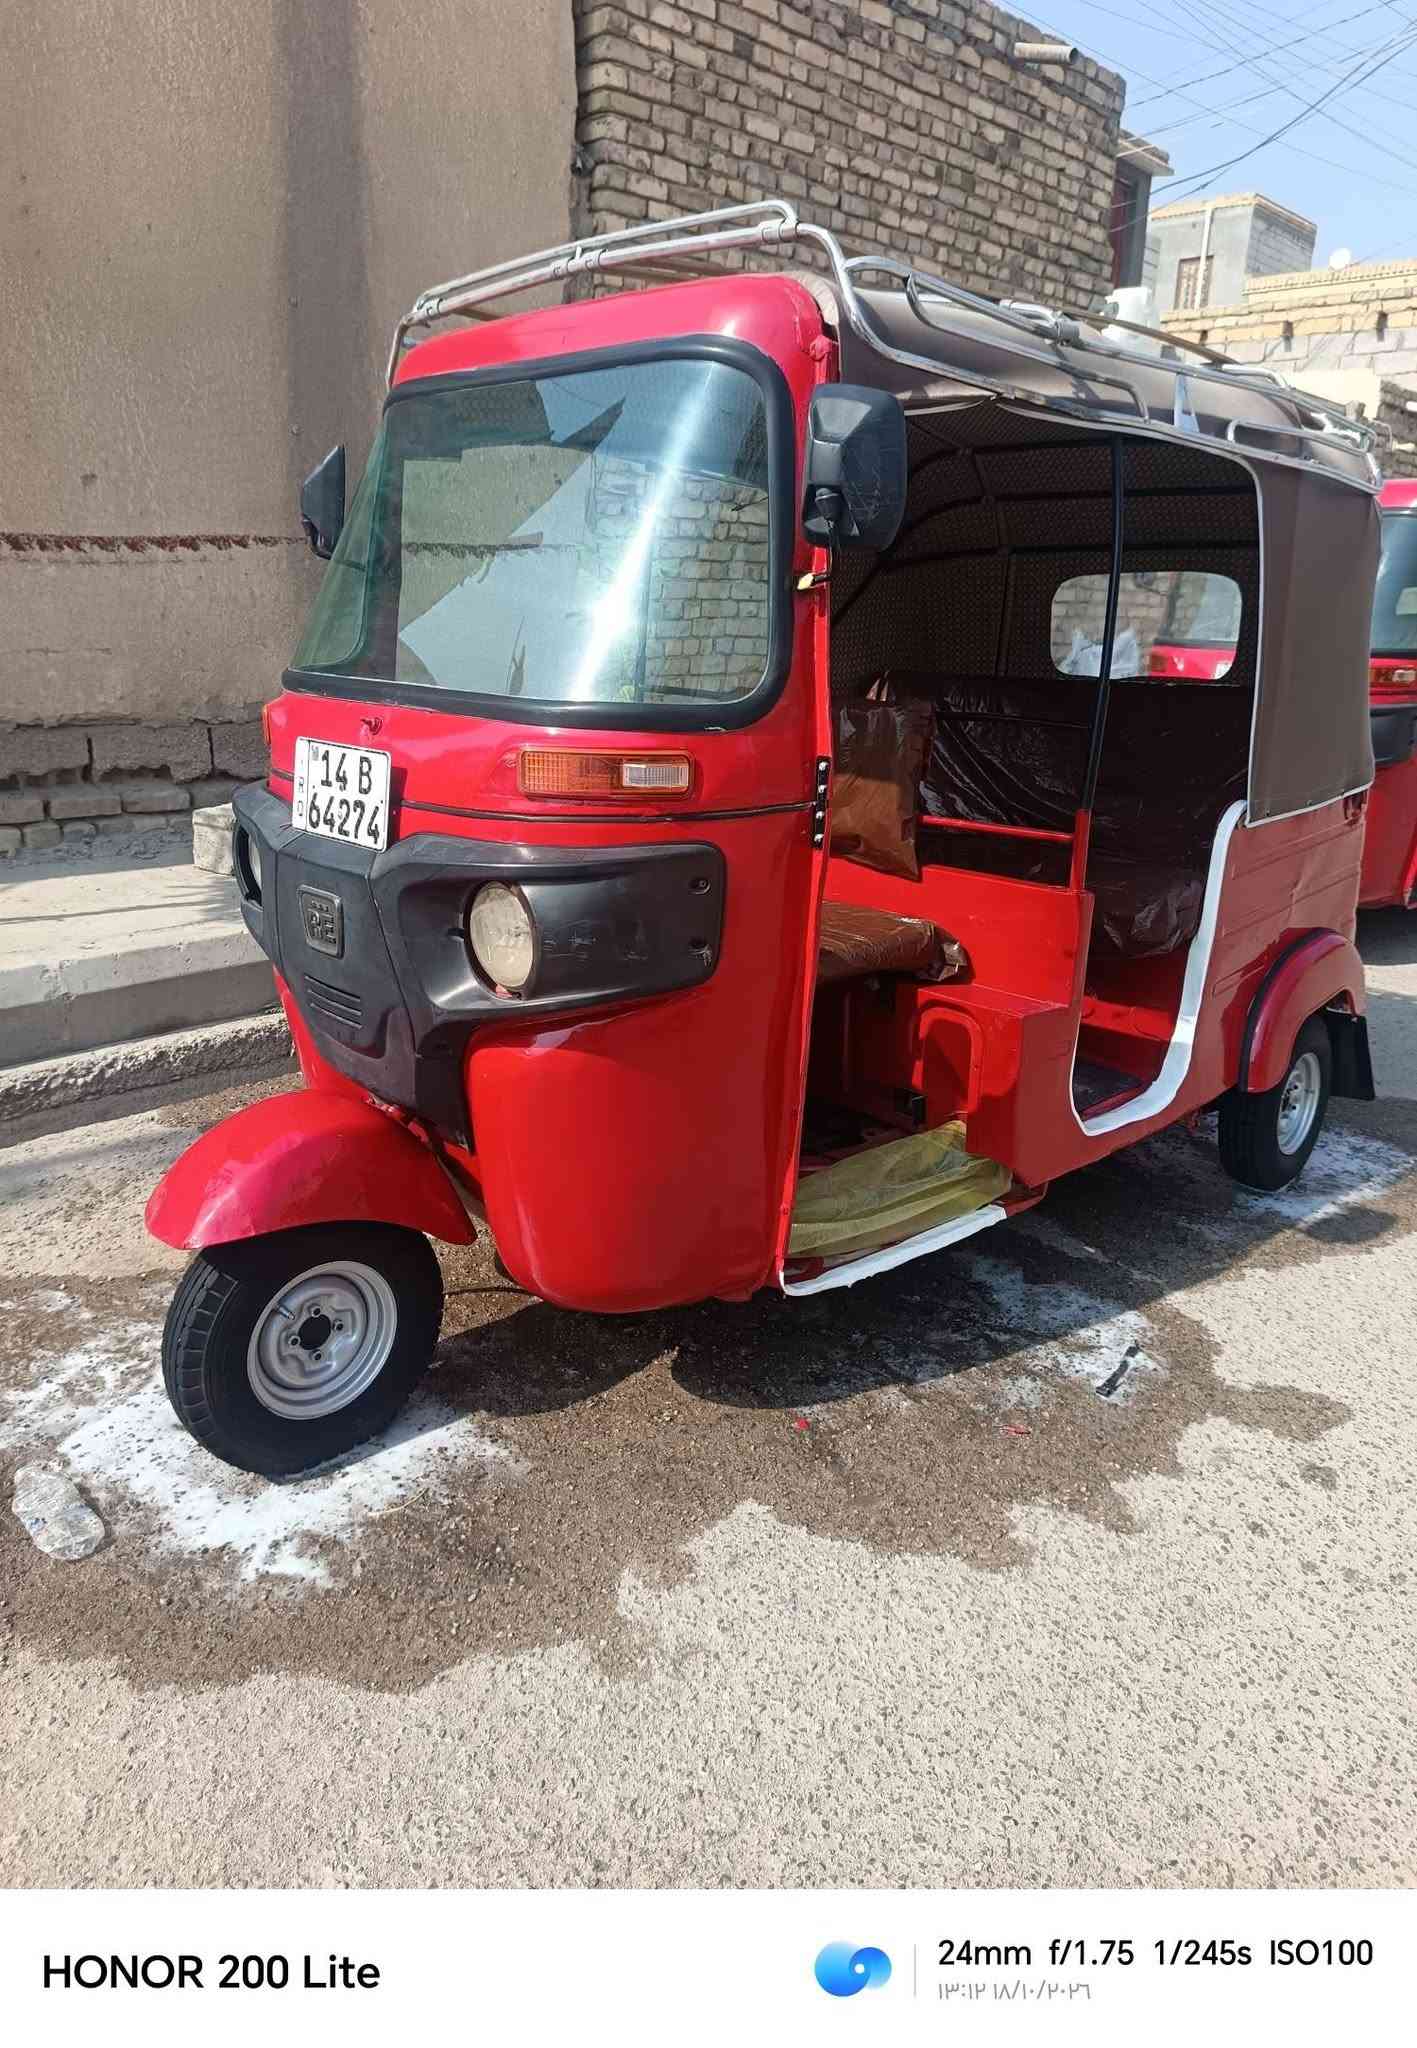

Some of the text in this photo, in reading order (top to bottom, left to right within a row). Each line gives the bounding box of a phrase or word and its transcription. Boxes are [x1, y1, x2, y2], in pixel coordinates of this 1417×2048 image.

[321, 750, 372, 795] 14 B
[308, 792, 380, 844] 64274
